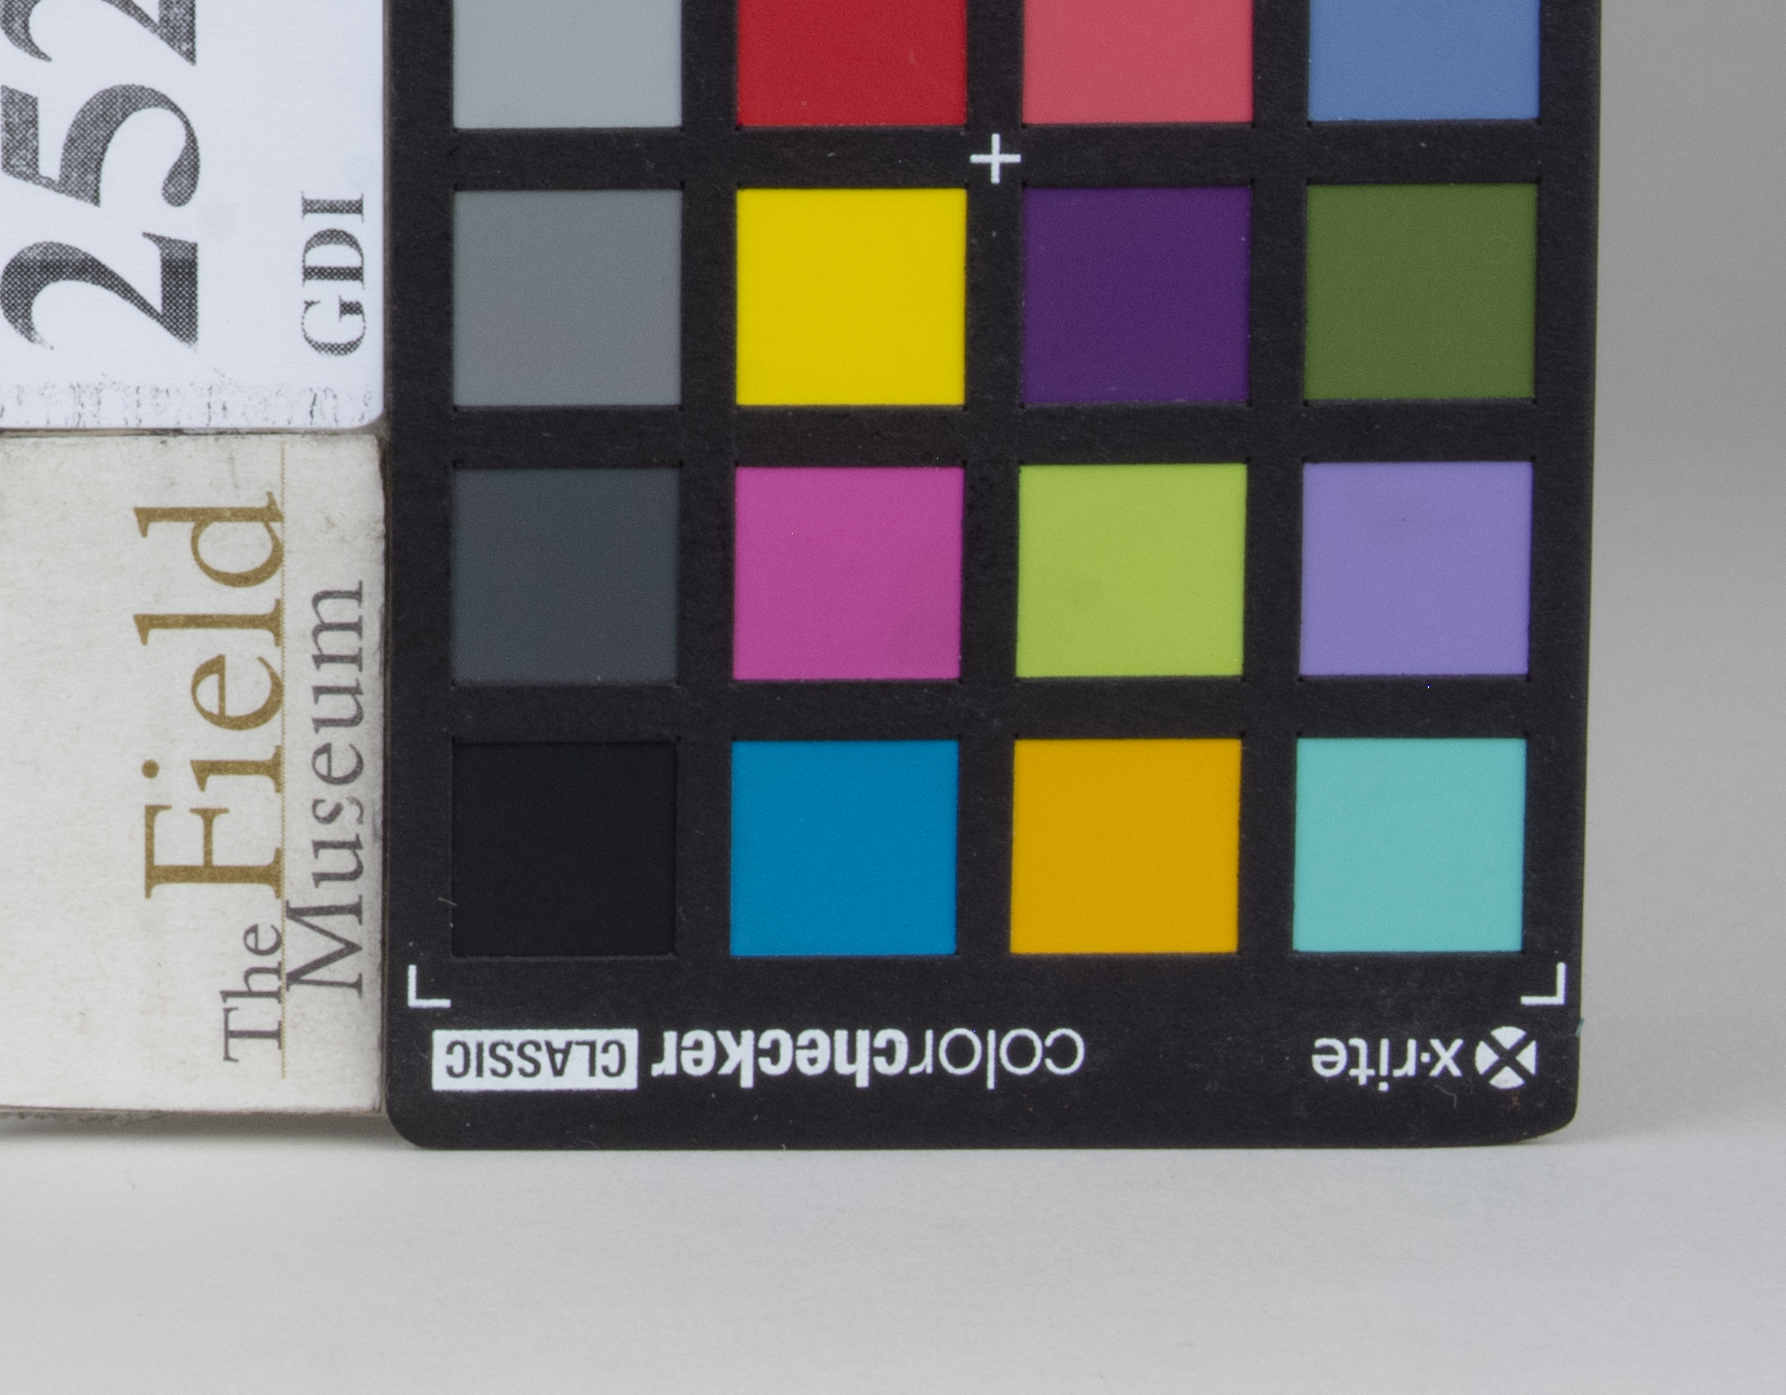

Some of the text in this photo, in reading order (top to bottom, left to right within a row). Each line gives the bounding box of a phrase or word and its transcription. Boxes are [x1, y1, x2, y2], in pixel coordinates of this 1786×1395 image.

[301, 190, 367, 357] GDI
[133, 491, 285, 1063] The Field
[285, 580, 364, 999] Museum
[444, 1027, 1086, 1089] colorchecker CLASSIC
